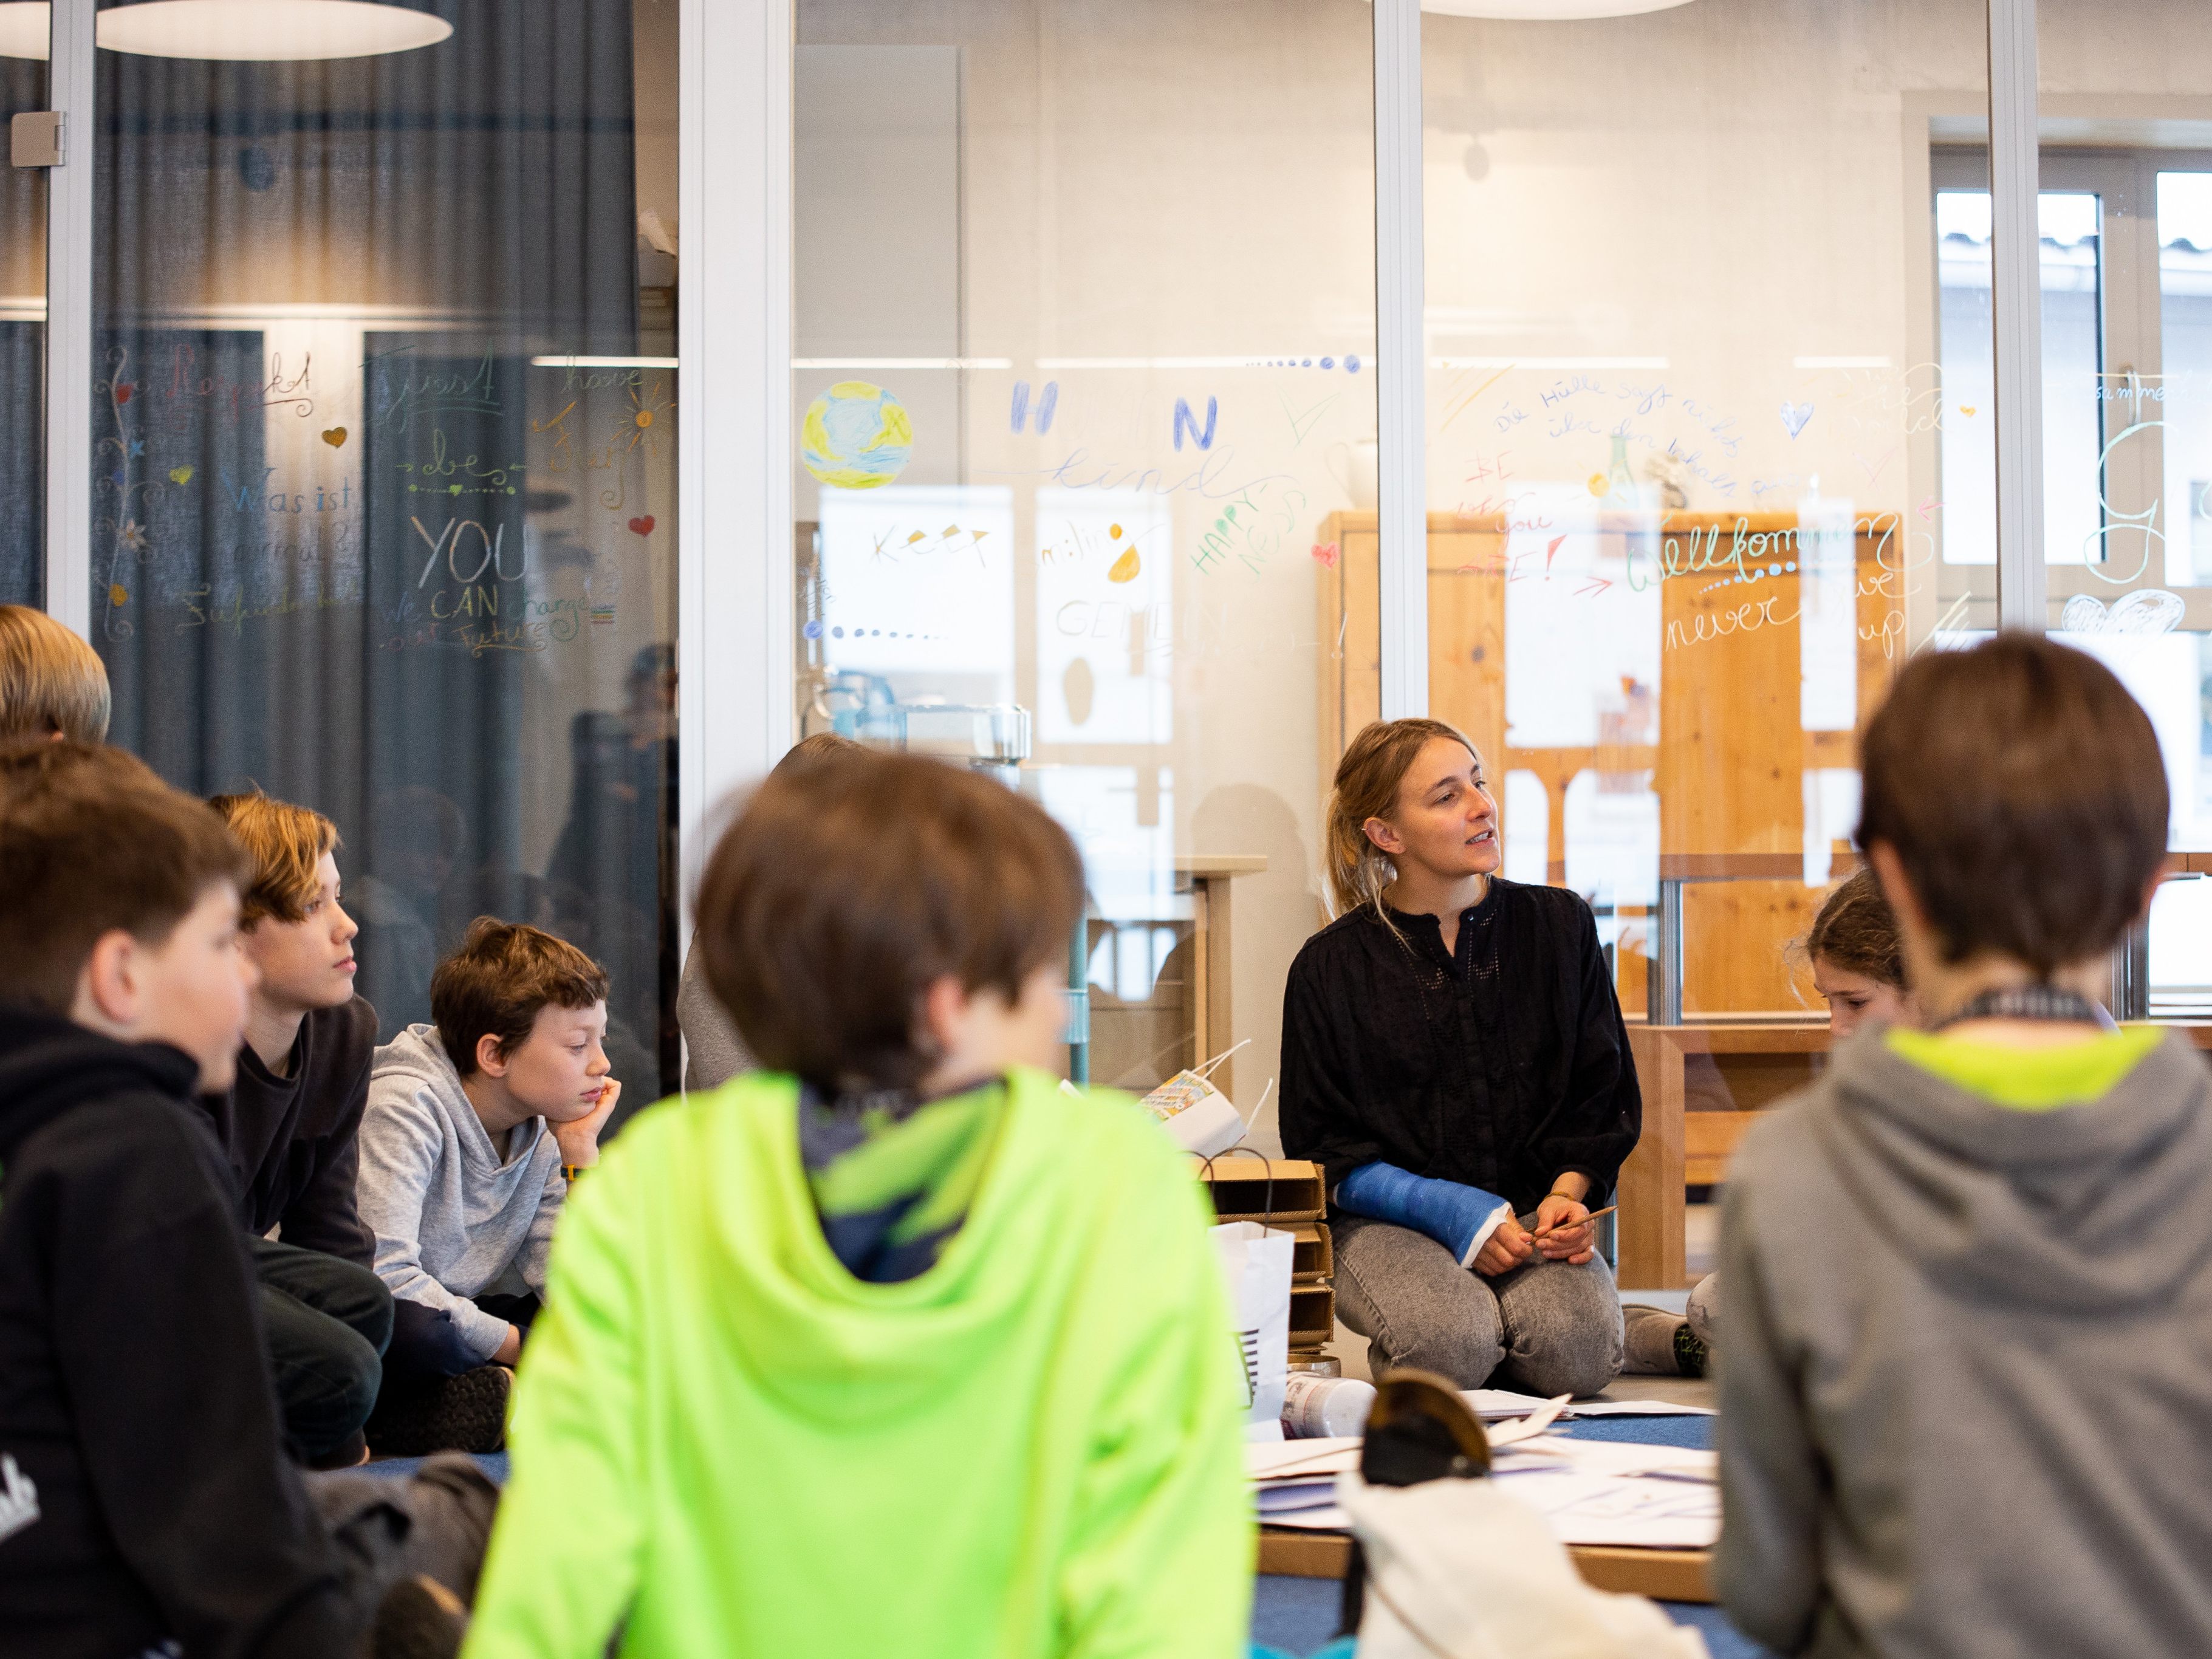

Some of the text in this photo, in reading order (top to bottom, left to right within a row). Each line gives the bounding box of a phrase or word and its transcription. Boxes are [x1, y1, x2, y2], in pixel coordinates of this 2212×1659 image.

[1494, 401, 1530, 434] Die
[1539, 374, 1607, 408] Hülle
[1549, 412, 1602, 439] über
[1612, 417, 1657, 448] den
[422, 428, 508, 486] be
[1027, 445, 1282, 499] kind
[1463, 448, 1516, 484] BE
[220, 466, 351, 515] Was ist
[410, 516, 527, 590] YOU
[1495, 515, 1554, 553] you
[430, 584, 499, 619] CAN
[1665, 596, 1804, 653] never
[1857, 609, 1906, 661] up
